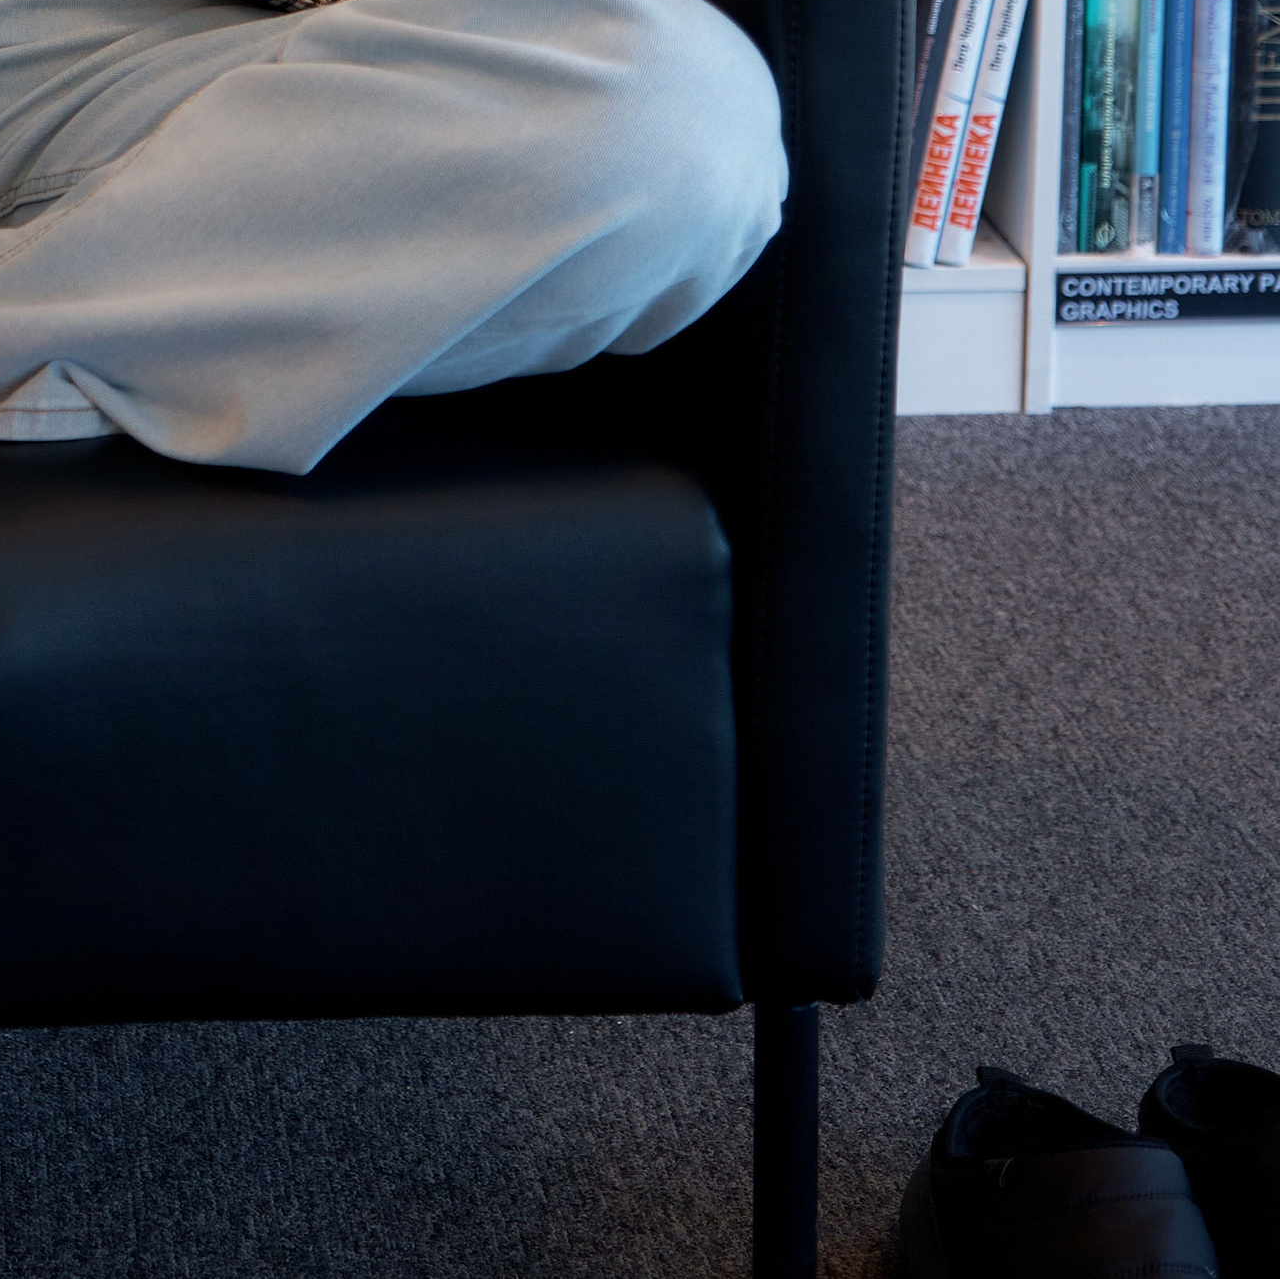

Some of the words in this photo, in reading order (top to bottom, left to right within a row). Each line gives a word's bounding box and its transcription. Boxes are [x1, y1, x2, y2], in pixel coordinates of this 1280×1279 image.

[913, 113, 960, 231] ДЕЙНЕКА
[949, 113, 997, 231] ДЕЙНЕКА
[1062, 276, 1255, 301] CONTEMPORARY
[1062, 299, 1179, 321] GRAPHICS
